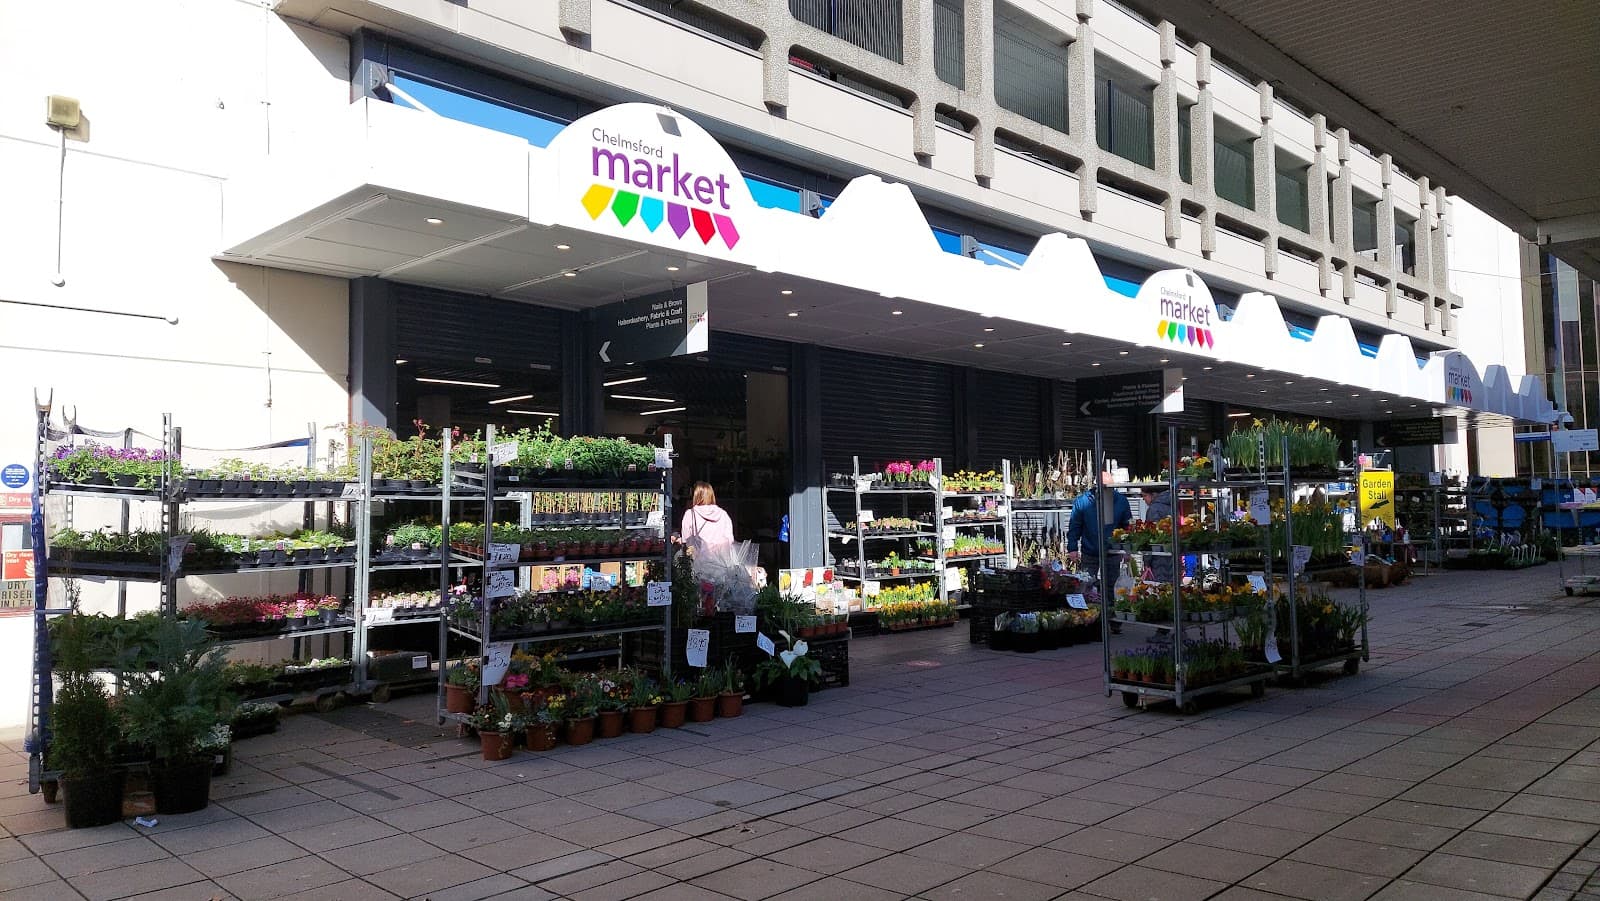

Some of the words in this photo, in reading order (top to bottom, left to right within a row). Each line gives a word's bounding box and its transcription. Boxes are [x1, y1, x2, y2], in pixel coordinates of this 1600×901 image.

[592, 127, 663, 159] Chelmsford
[592, 146, 731, 210] market
[650, 311, 666, 319] Fabric
[670, 307, 683, 316] Craft
[1160, 295, 1211, 327] market
[645, 321, 660, 330] Plants
[664, 317, 683, 326] Flowers
[1448, 370, 1471, 389] market
[1362, 478, 1392, 489] Garden
[8, 496, 21, 505] Dry
[1368, 490, 1387, 500] Stall
[7, 580, 28, 590] DRY
[1, 590, 32, 600] RISER
